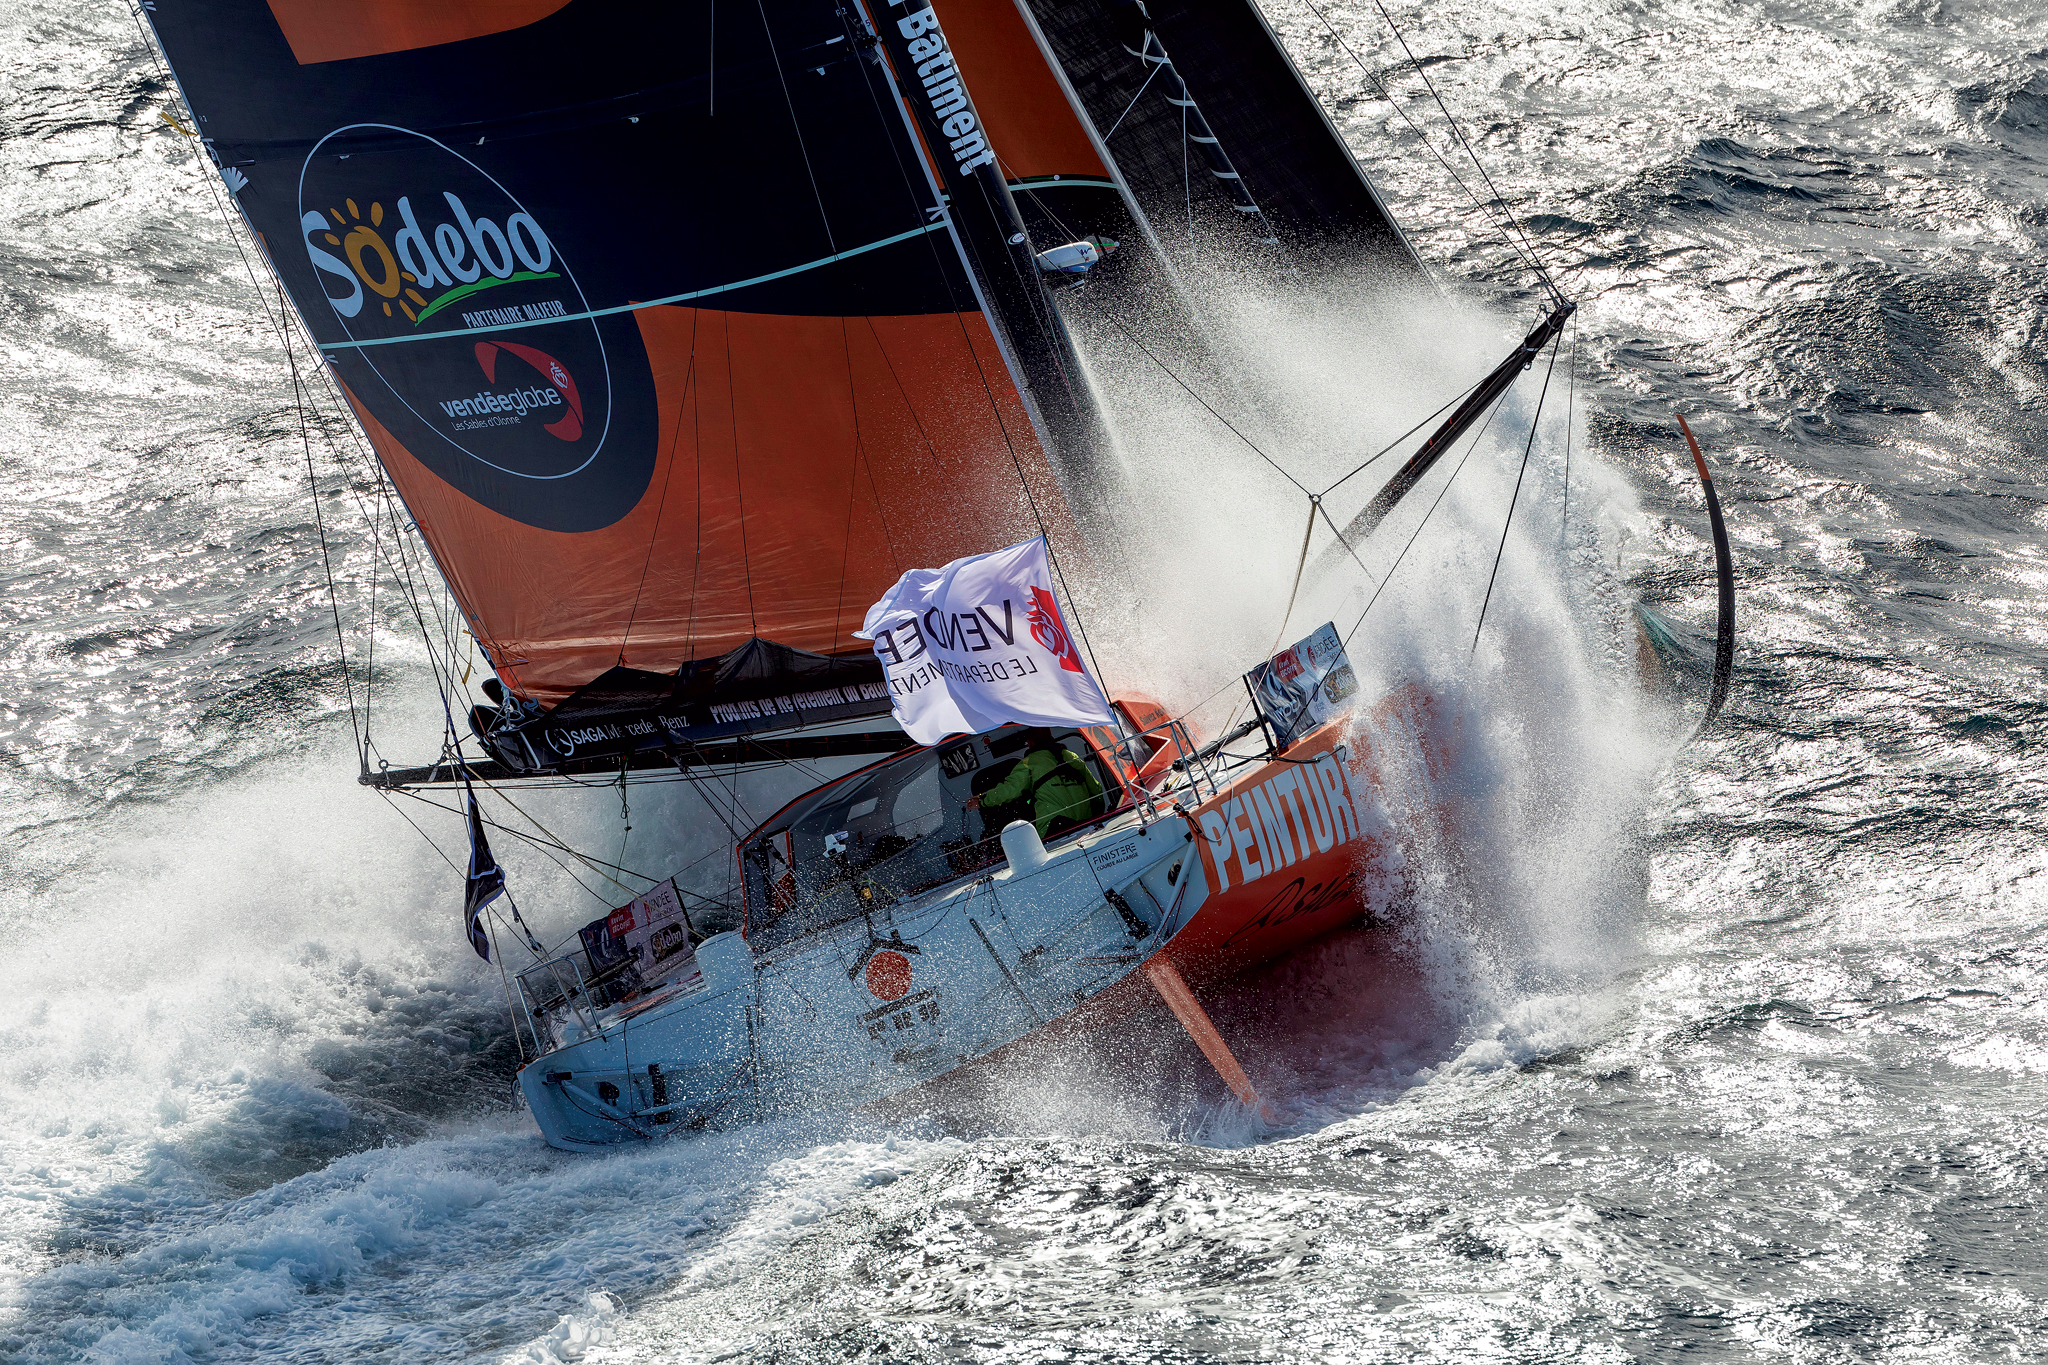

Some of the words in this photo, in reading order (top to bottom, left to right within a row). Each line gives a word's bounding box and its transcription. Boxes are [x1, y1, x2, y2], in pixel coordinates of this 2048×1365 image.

[896, 5, 995, 177] Bâtiment
[301, 191, 552, 318] Sodebo
[462, 305, 526, 329] PARTENAIRE
[522, 300, 567, 320] MAJEUR
[451, 421, 464, 431] Les
[463, 418, 489, 430] Sables
[488, 415, 521, 427] d'Olonne
[571, 726, 609, 745] SAGA
[1096, 860, 1116, 872] COURSE
[1124, 852, 1139, 862] LARGE
